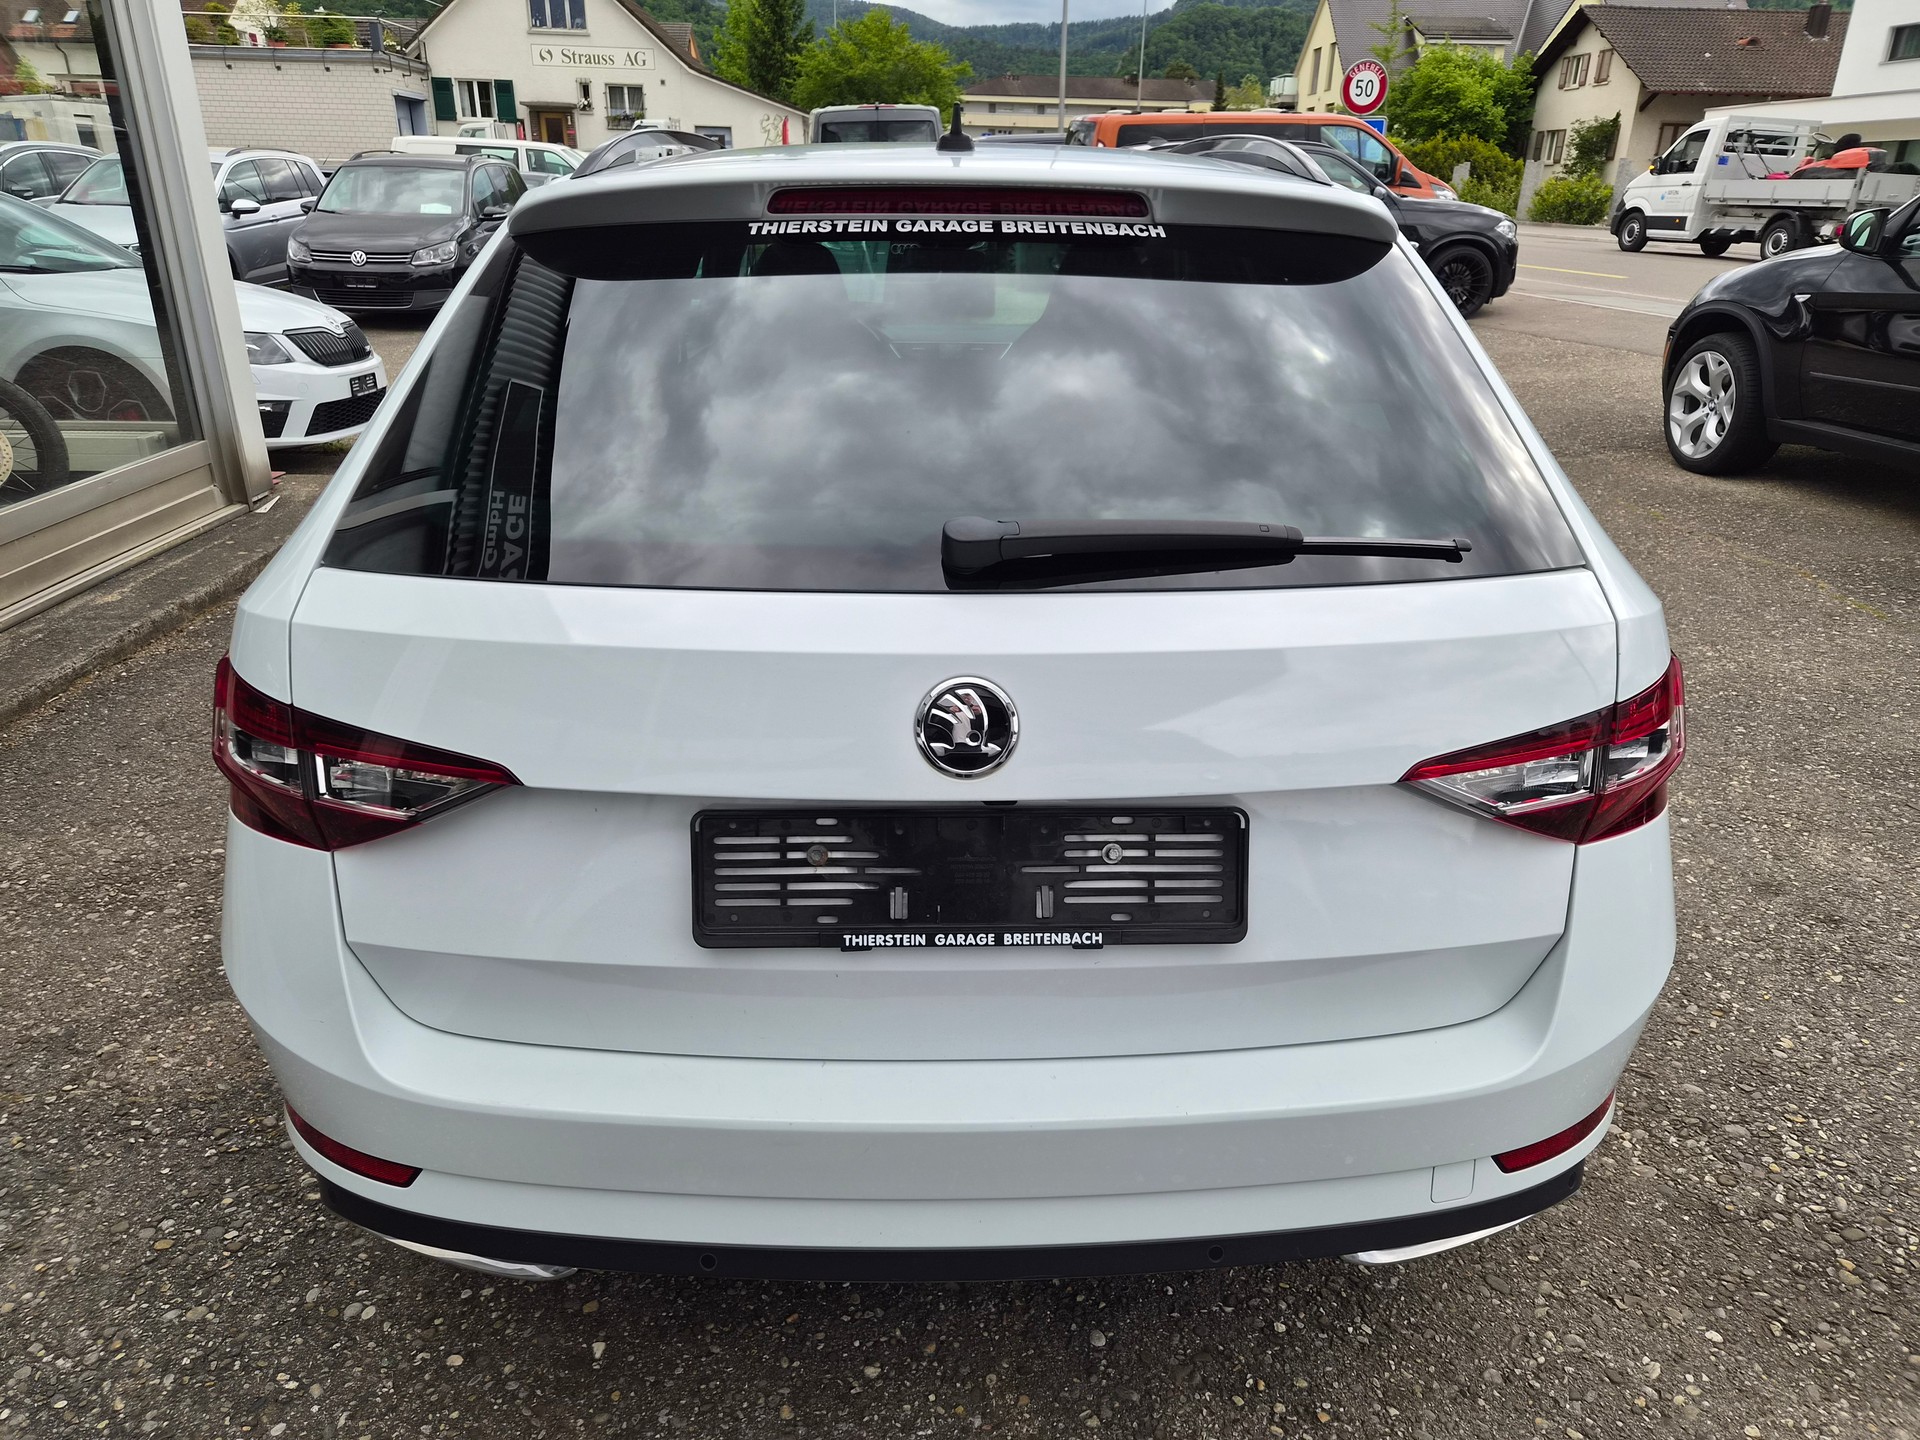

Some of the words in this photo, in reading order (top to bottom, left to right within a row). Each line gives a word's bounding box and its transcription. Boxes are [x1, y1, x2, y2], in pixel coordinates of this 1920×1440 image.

[561, 48, 615, 66] Strauss
[623, 51, 647, 66] AG
[1349, 62, 1386, 80] GENERELL
[1355, 79, 1374, 97] 50
[748, 220, 889, 235] THIERSTEIN
[896, 220, 994, 232] GARAGE
[1001, 220, 1167, 238] BREITENBACH
[843, 934, 926, 947] THIERSTEIN
[934, 933, 995, 946] GARAGE
[1003, 932, 1103, 945] BREITENBACH
